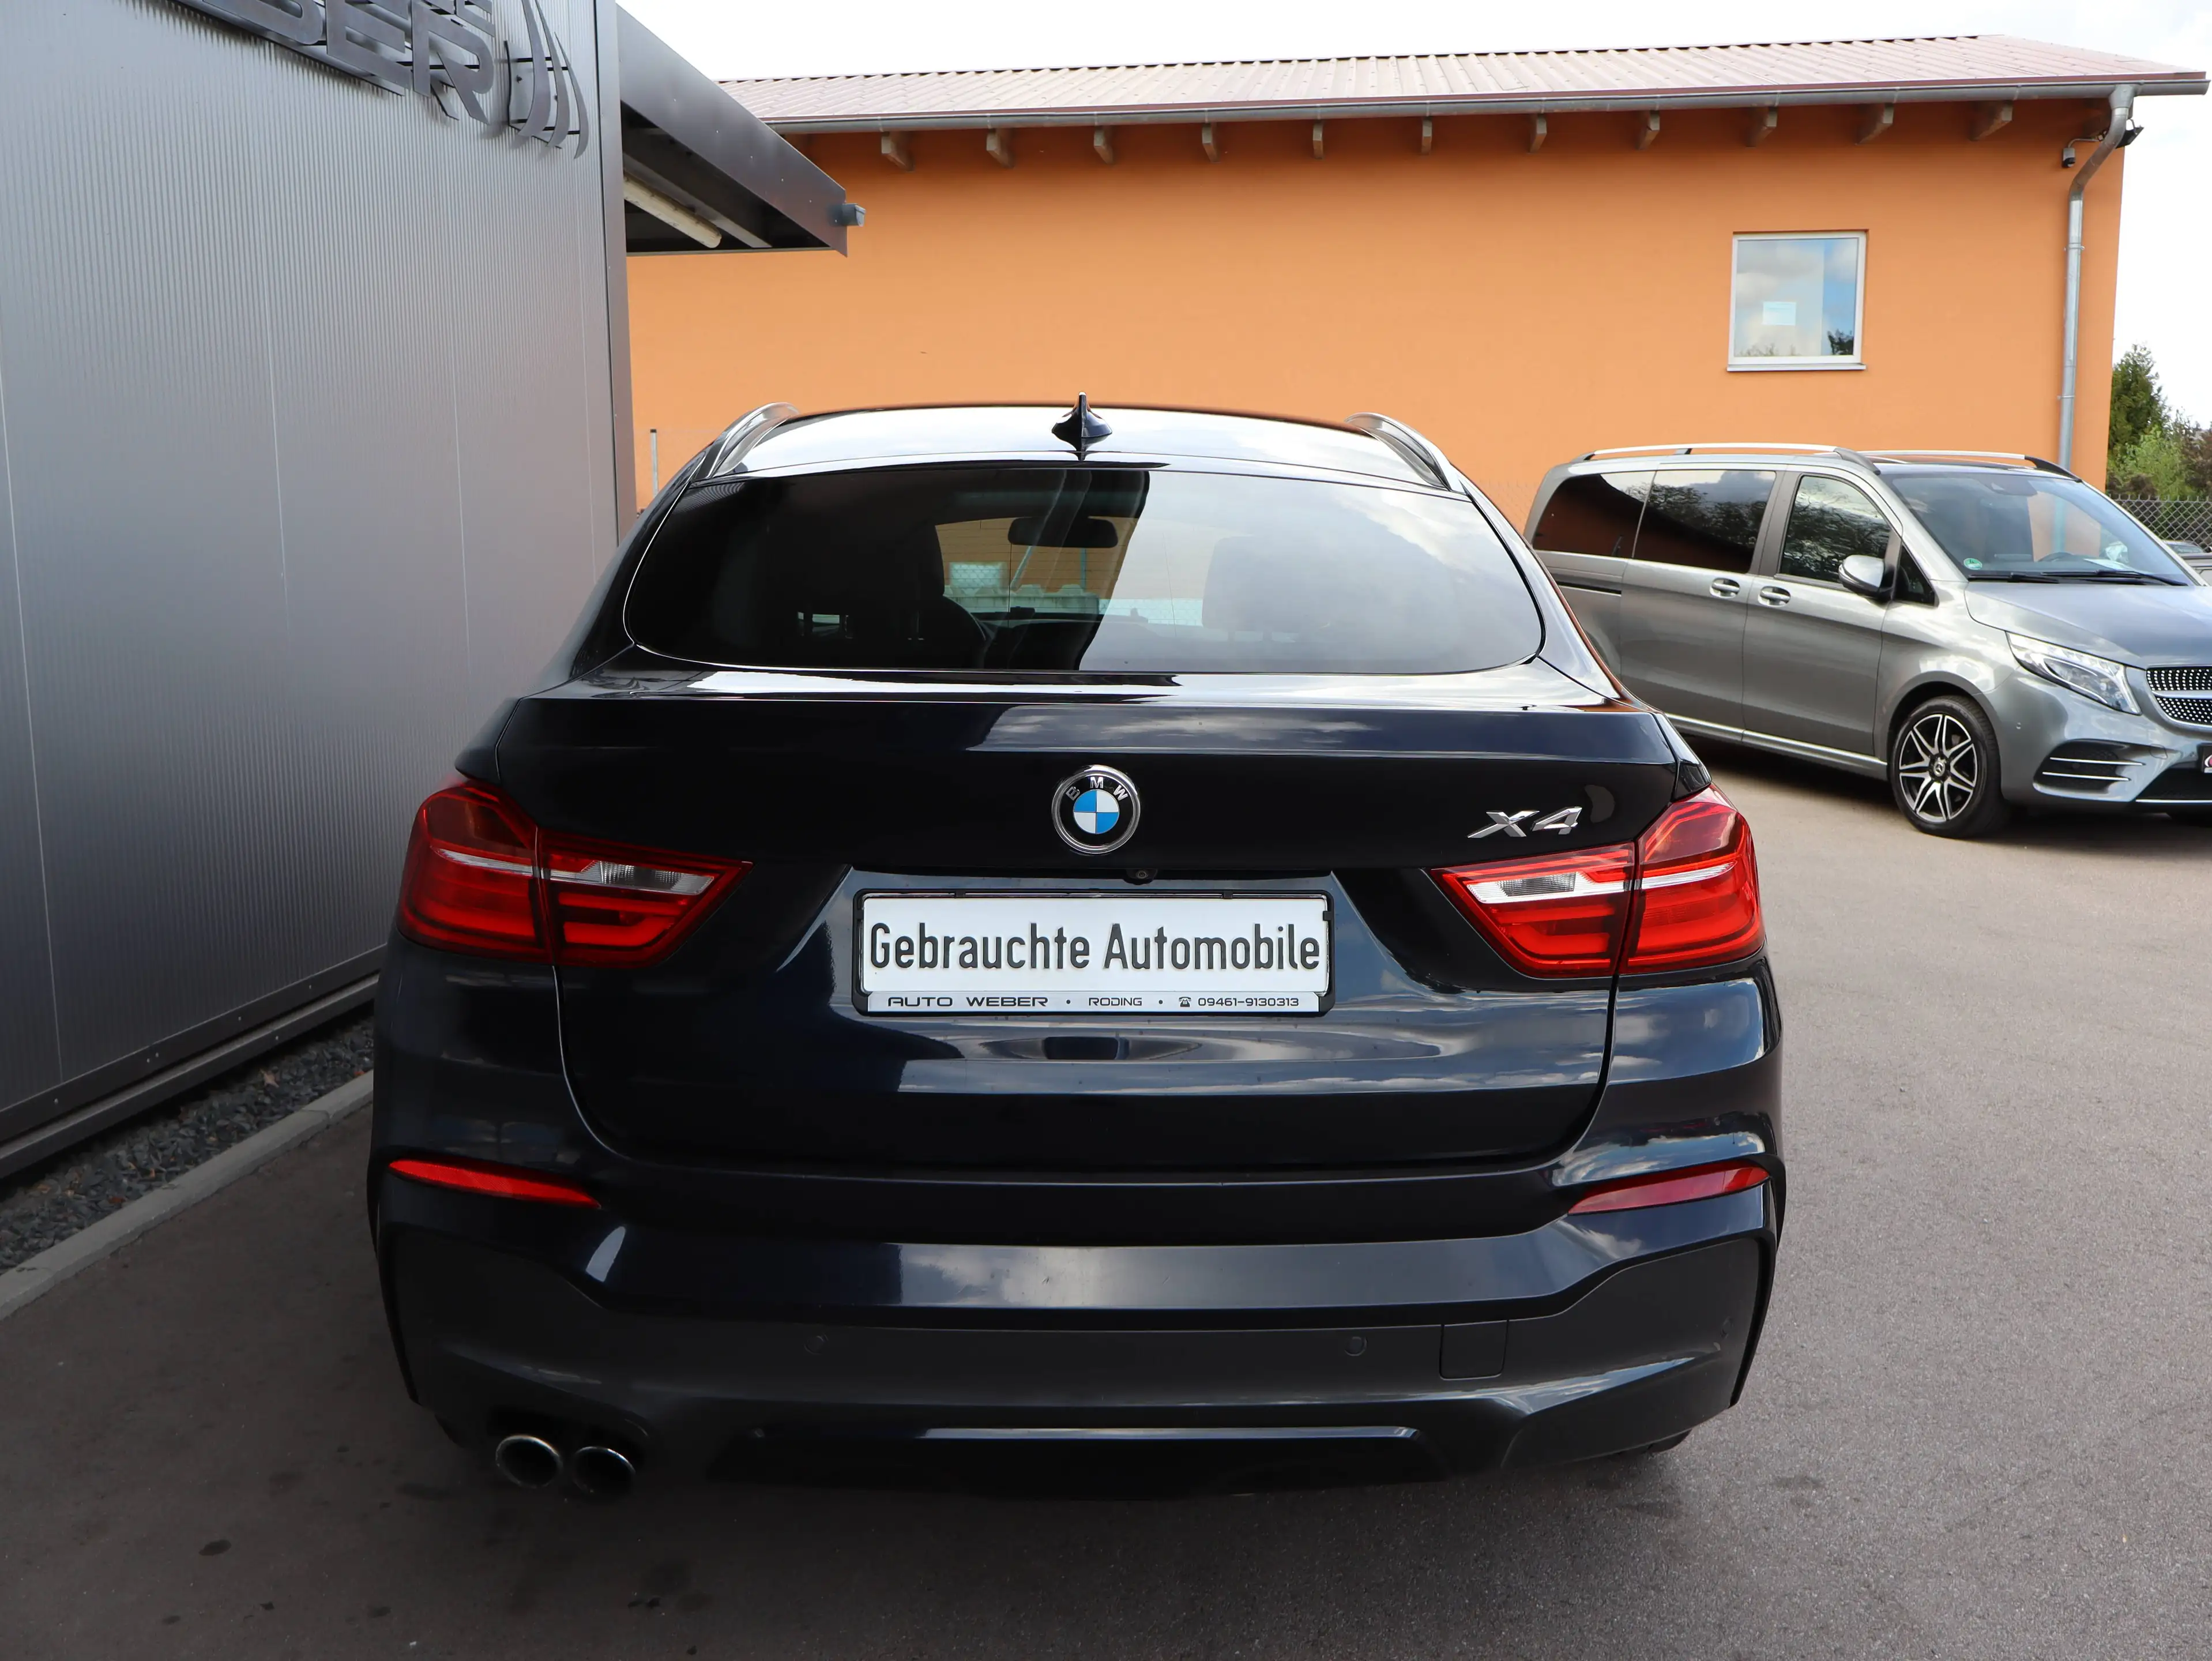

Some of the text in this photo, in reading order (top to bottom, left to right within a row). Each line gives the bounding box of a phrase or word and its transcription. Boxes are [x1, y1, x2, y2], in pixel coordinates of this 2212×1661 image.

[1066, 776, 1128, 801] BMW
[1467, 806, 1582, 838] X4
[871, 922, 1320, 969] Gebrauchte Automobile
[887, 997, 1299, 1006] AUTO WEBER RODING 09461-9130313
